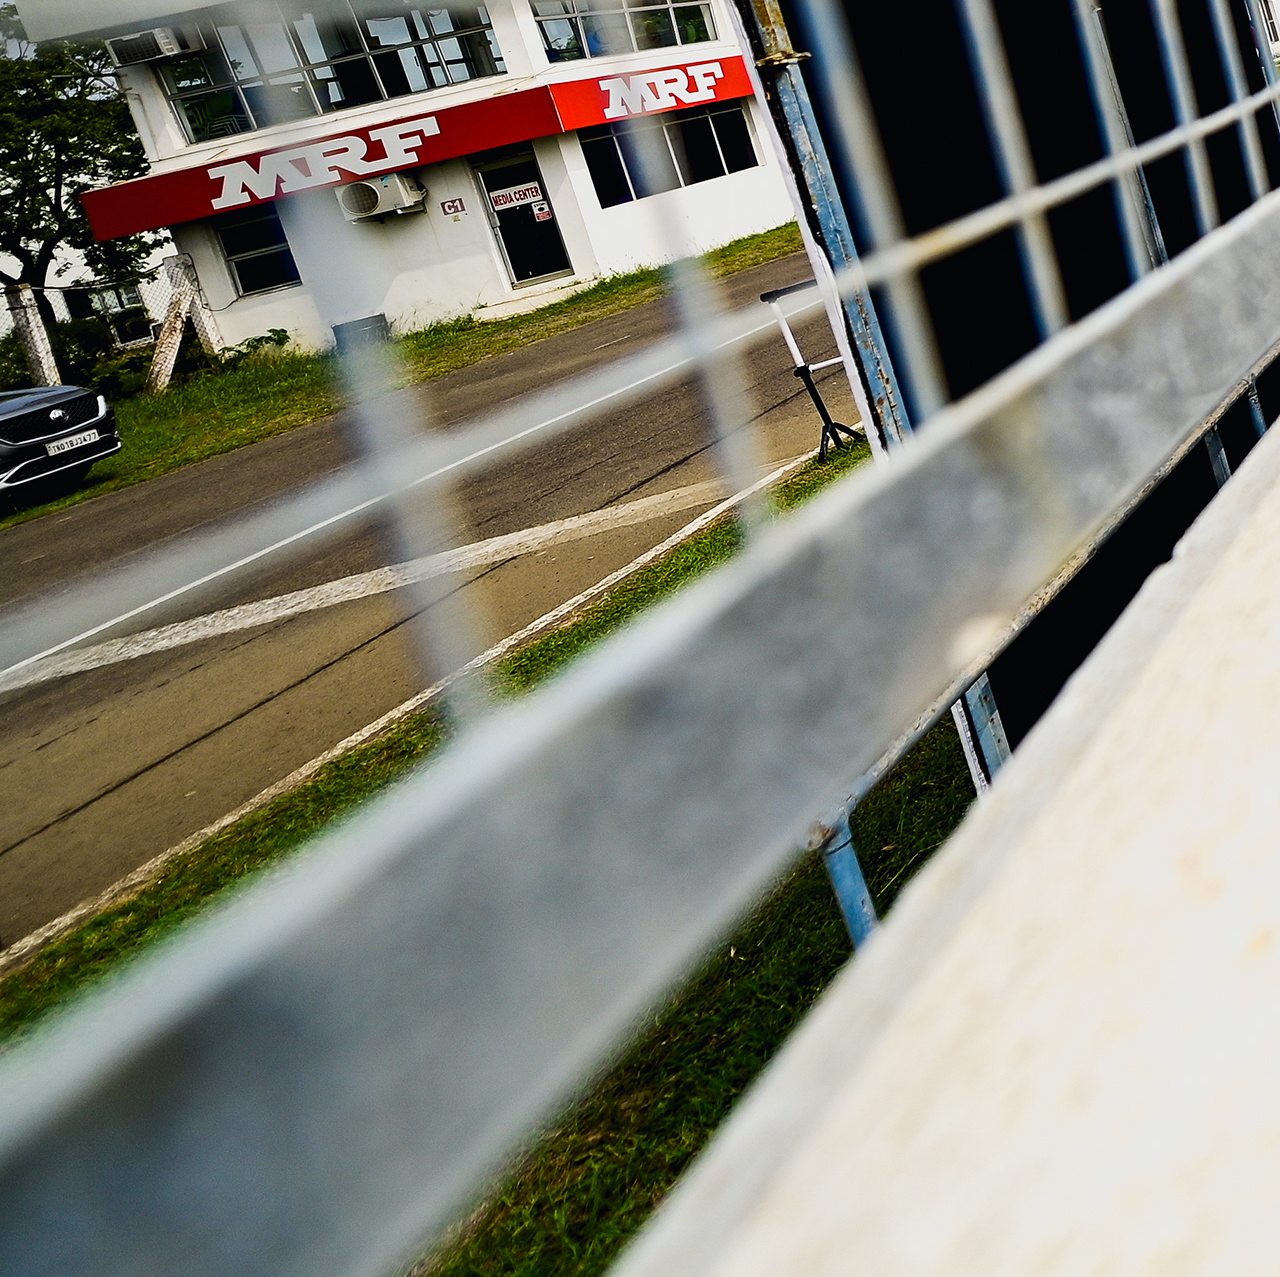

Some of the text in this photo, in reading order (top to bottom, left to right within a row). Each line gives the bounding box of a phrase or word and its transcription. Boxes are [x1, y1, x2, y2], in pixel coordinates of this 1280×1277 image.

[598, 61, 724, 119] MRF
[207, 116, 441, 210] MRF
[444, 200, 463, 214] C1
[492, 186, 541, 206] MEDIA CENTER
